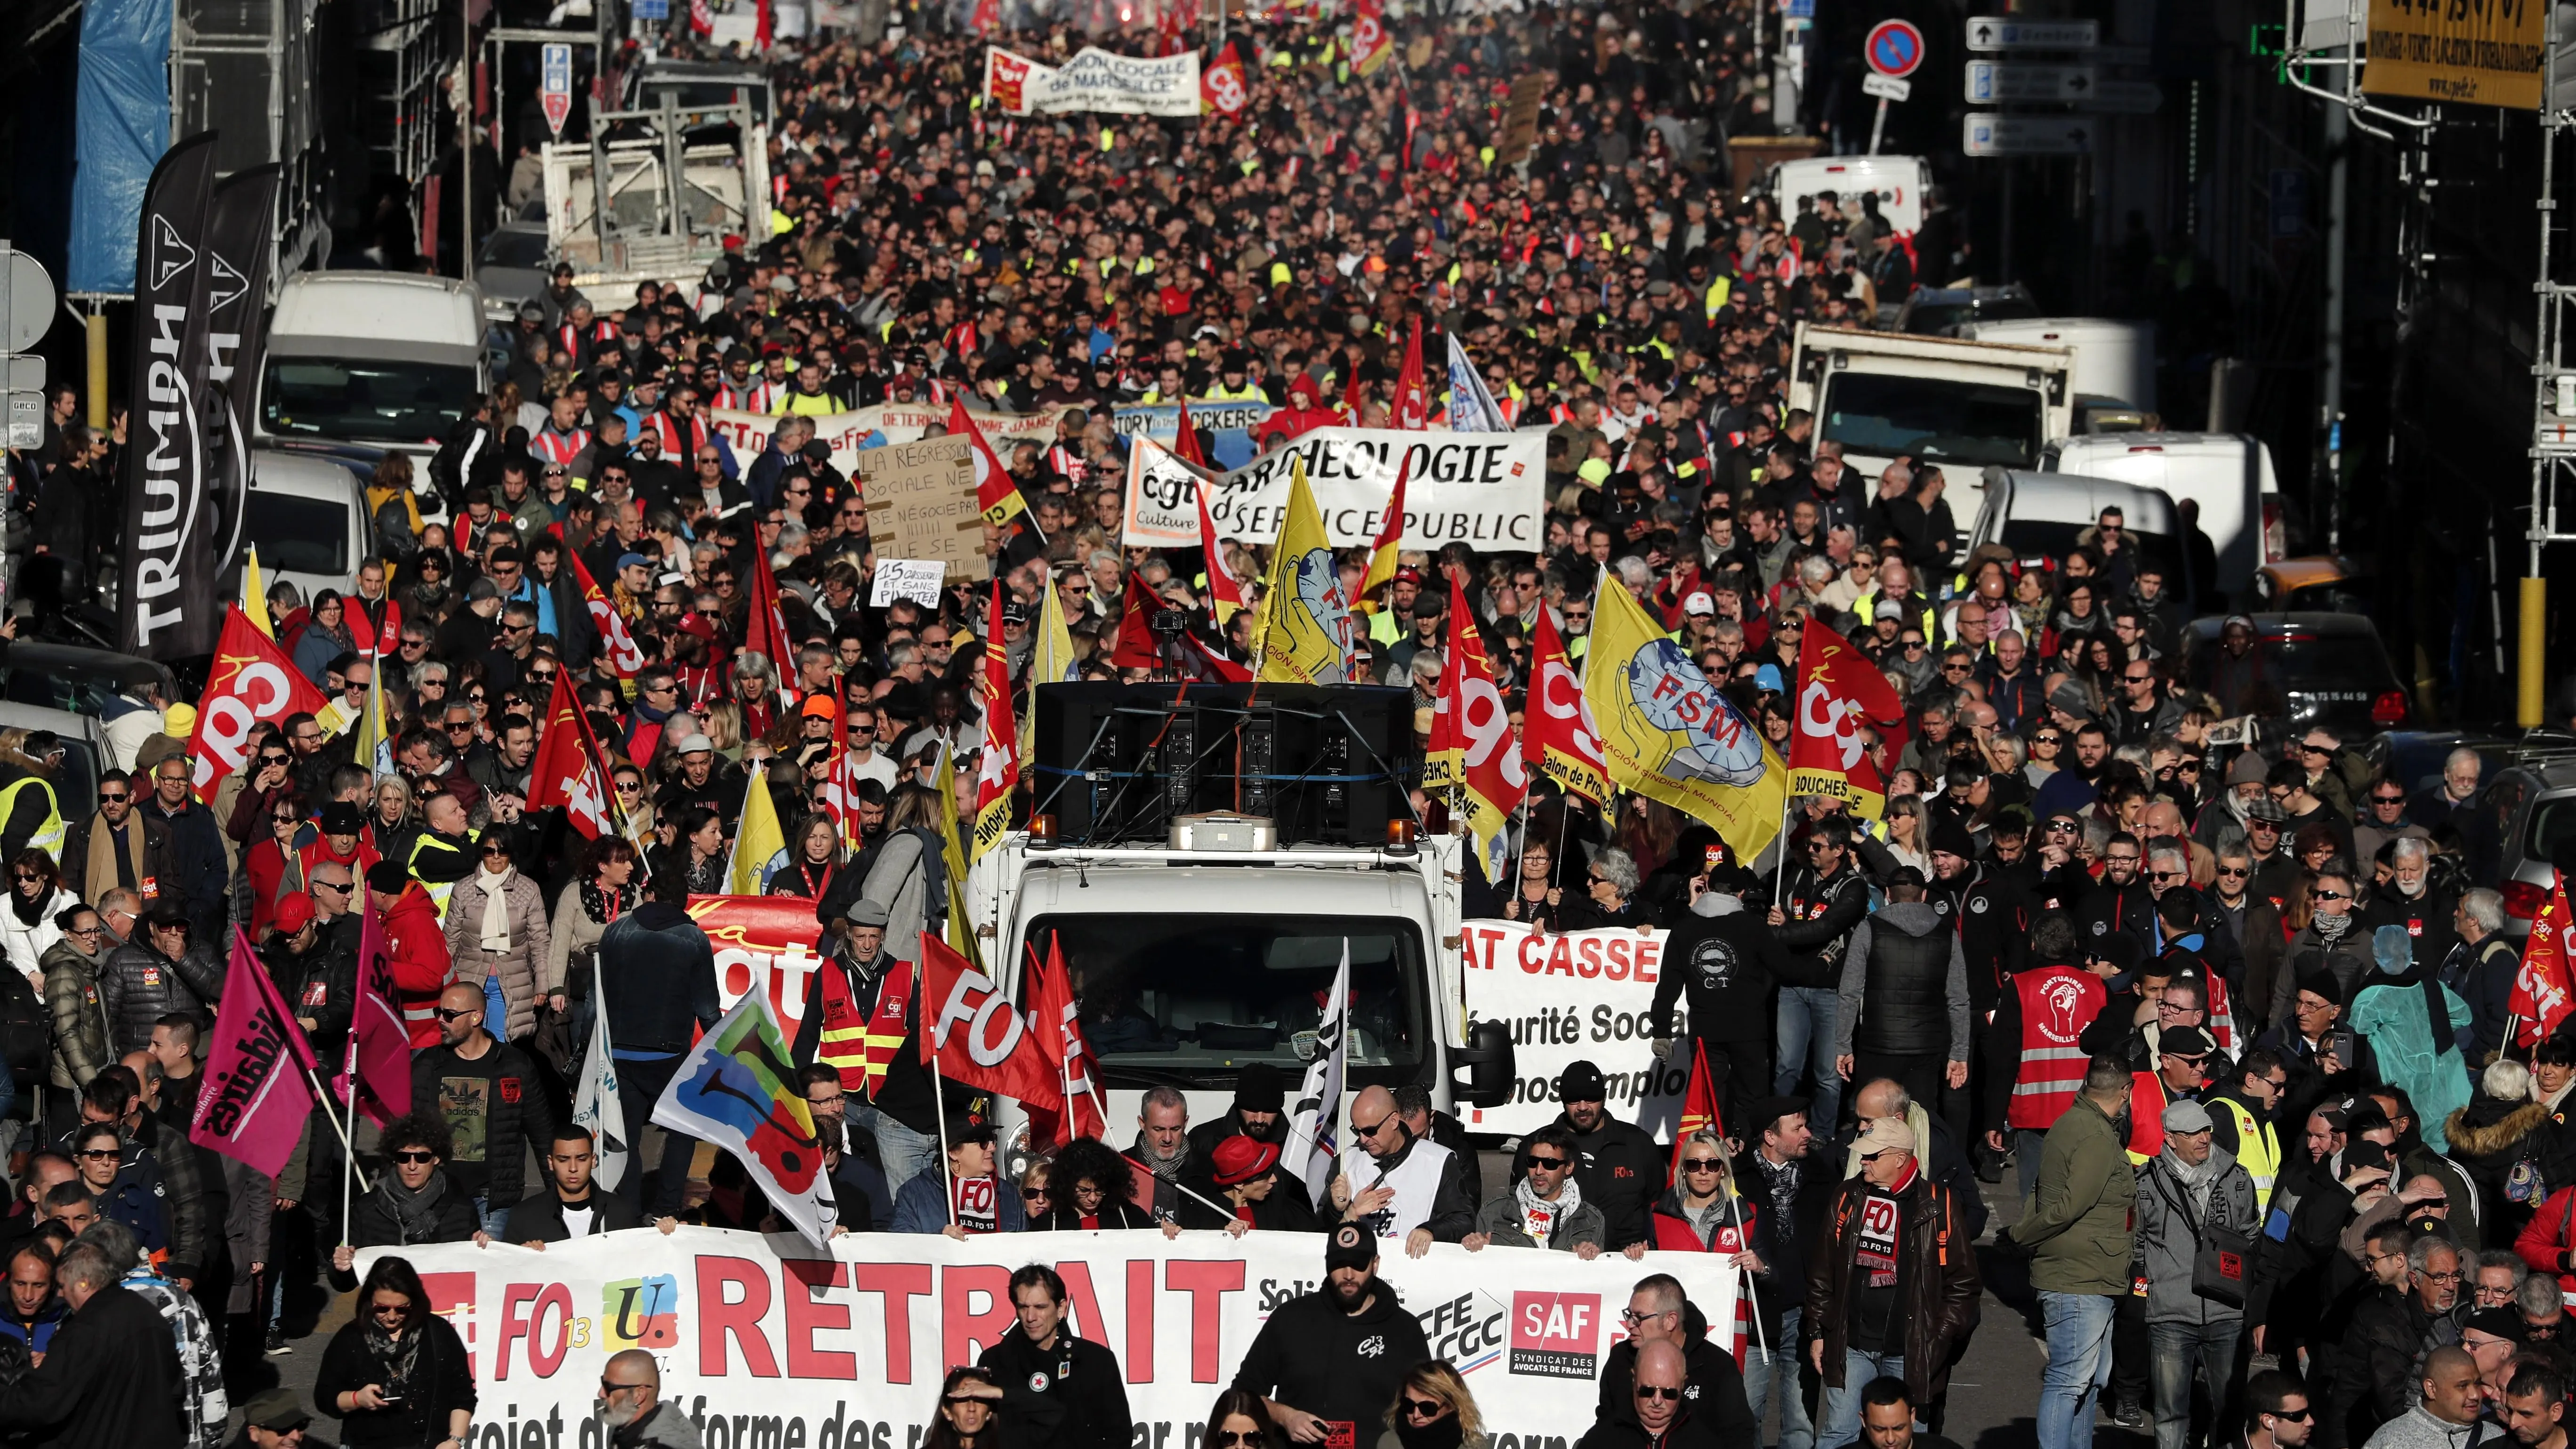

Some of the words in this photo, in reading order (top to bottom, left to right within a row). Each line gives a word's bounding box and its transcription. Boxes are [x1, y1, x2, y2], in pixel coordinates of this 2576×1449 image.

[1115, 59, 1187, 75] LOCALE
[1050, 80, 1070, 93] de
[14, 402, 36, 411] GECO
[974, 419, 1004, 433] OMME
[1009, 416, 1055, 434] JAMAIS
[1178, 409, 1258, 430] OCKERS
[860, 451, 886, 473] LA
[137, 304, 186, 647] TRIUMPH
[946, 470, 971, 487] NE
[1143, 475, 1196, 510] cgt
[872, 511, 893, 526] SE
[959, 500, 979, 515] PAS
[1136, 511, 1198, 530] Culture
[1232, 507, 1380, 535] SERICE
[1402, 513, 1530, 541] PUBLIC
[930, 539, 956, 555] SE
[877, 562, 903, 580] 15
[902, 581, 934, 590] SANS
[1652, 672, 1742, 750] FSM
[1540, 749, 1567, 779] Salon
[1569, 767, 1583, 786] de
[1795, 776, 1848, 797] BOUCHES
[1641, 769, 1690, 793] SINDICAL
[1692, 789, 1737, 827] MUNDIAL
[1707, 850, 1723, 861] cgt
[143, 883, 157, 892] cgt
[288, 907, 298, 917] M
[2408, 926, 2422, 935] cgt
[2536, 920, 2553, 936] cgt
[1518, 935, 1659, 983] CASSE
[145, 972, 158, 981] cgt
[2039, 975, 2085, 995] PORTUAIRES
[935, 969, 1025, 1066] FO
[1466, 1006, 1580, 1046] éurité
[1591, 1004, 1686, 1043] Soca
[2038, 1022, 2076, 1043] MARSEILLE
[1601, 1059, 1684, 1106] mplo
[448, 1107, 480, 1116] adidas
[961, 1180, 994, 1214] FO
[960, 1219, 974, 1227] U.D.
[975, 1222, 985, 1230] FO
[1525, 1218, 1548, 1232] cgt
[1863, 1201, 1894, 1234] FO
[1871, 1244, 1881, 1252] FO
[695, 1254, 1247, 1385] RETRAIT
[1417, 1291, 1473, 1340] CFE
[1524, 1303, 1591, 1340] SAF
[495, 1282, 573, 1381] FO
[563, 1317, 592, 1349] 13
[1370, 1336, 1383, 1347] 13
[1436, 1311, 1503, 1364] CGC
[1357, 1338, 1385, 1359] Cgt
[1513, 1363, 1549, 1374] AVOCATS
[1550, 1365, 1560, 1374] DE
[1561, 1366, 1593, 1377] FRANCE
[1514, 1353, 1568, 1367] SYNDICAT
[1573, 1357, 1594, 1368] DES
[1684, 1390, 1699, 1400] cgt
[672, 1395, 806, 1449] forme
[821, 1400, 892, 1449] des
